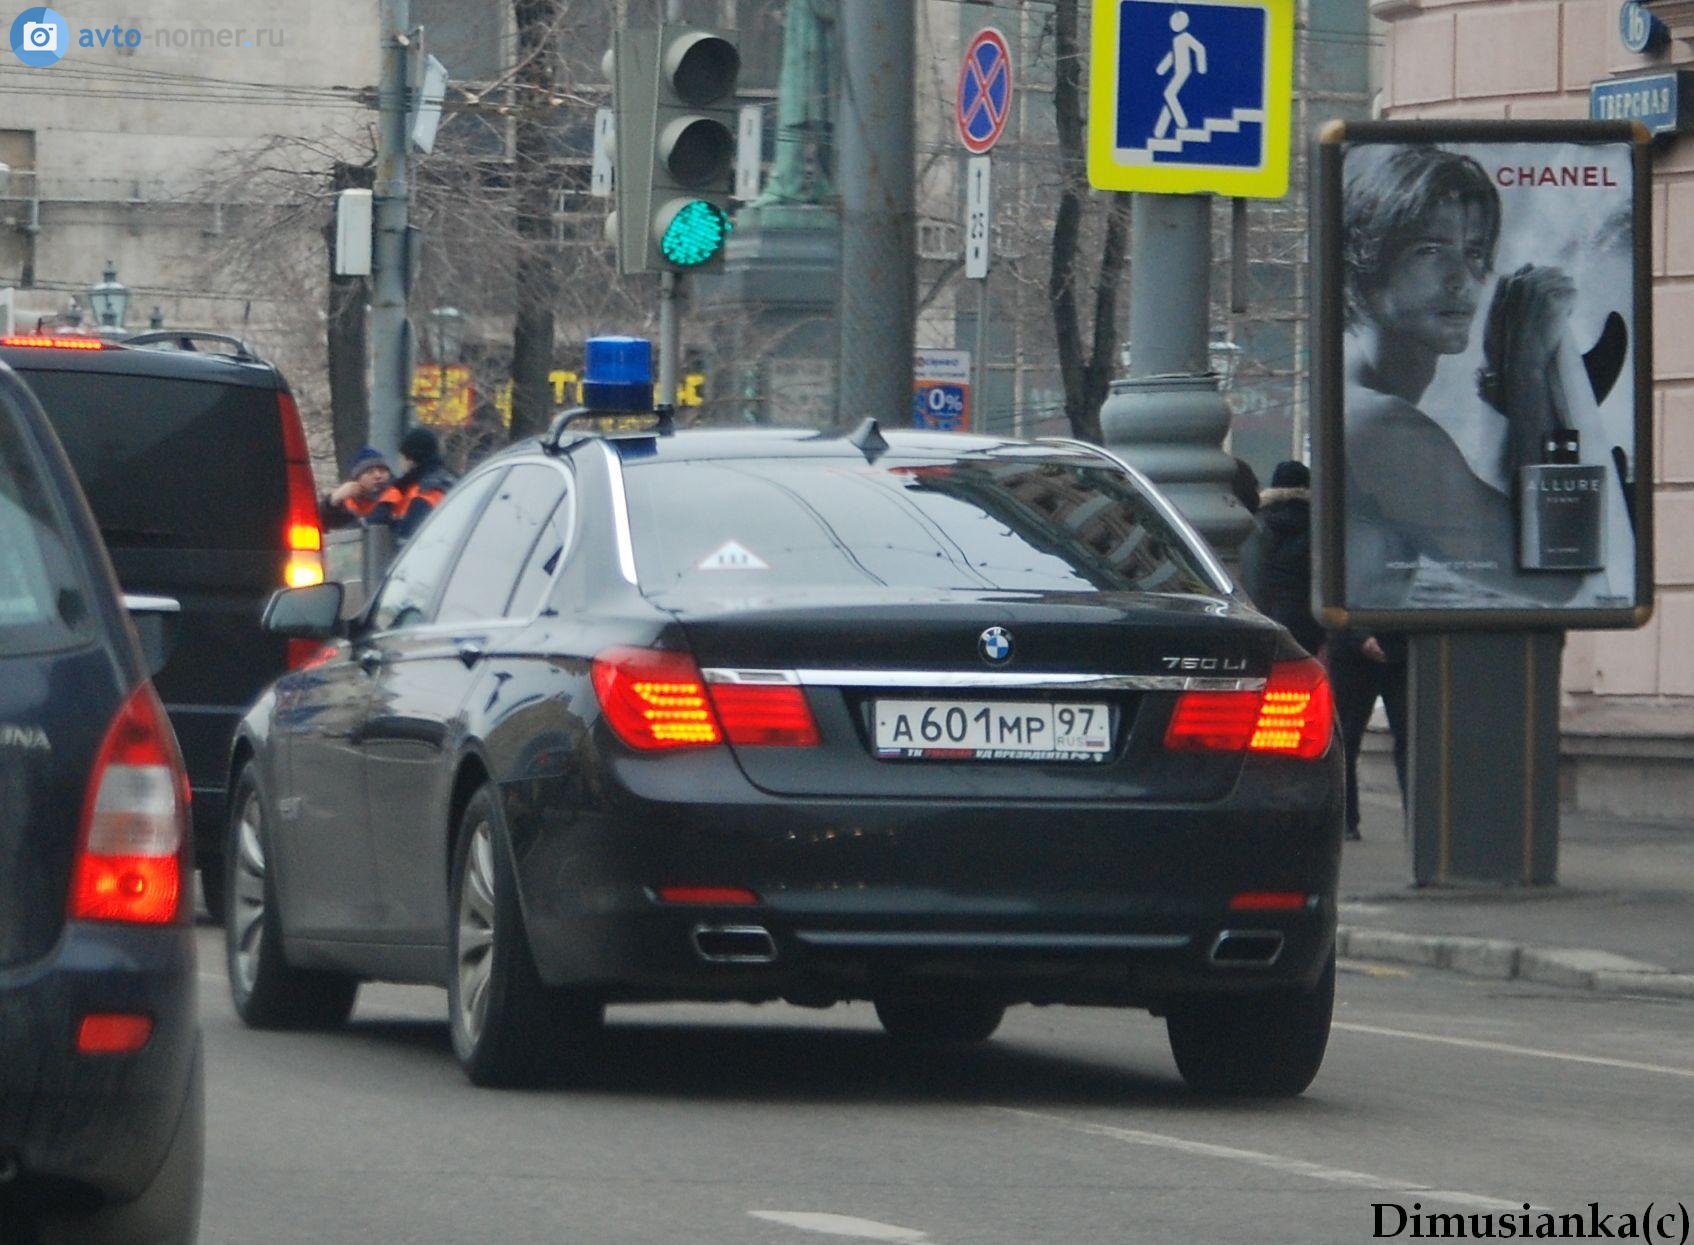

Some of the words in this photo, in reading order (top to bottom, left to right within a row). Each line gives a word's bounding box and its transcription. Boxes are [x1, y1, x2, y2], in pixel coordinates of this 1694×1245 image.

[1598, 87, 1670, 121] ТВЕРСКАЯ
[1497, 166, 1617, 188] CHANEL
[1526, 479, 1601, 493] ALLURE
[893, 706, 1045, 744] А601МР
[1058, 708, 1095, 736] 97
[1057, 735, 1085, 747] RUS
